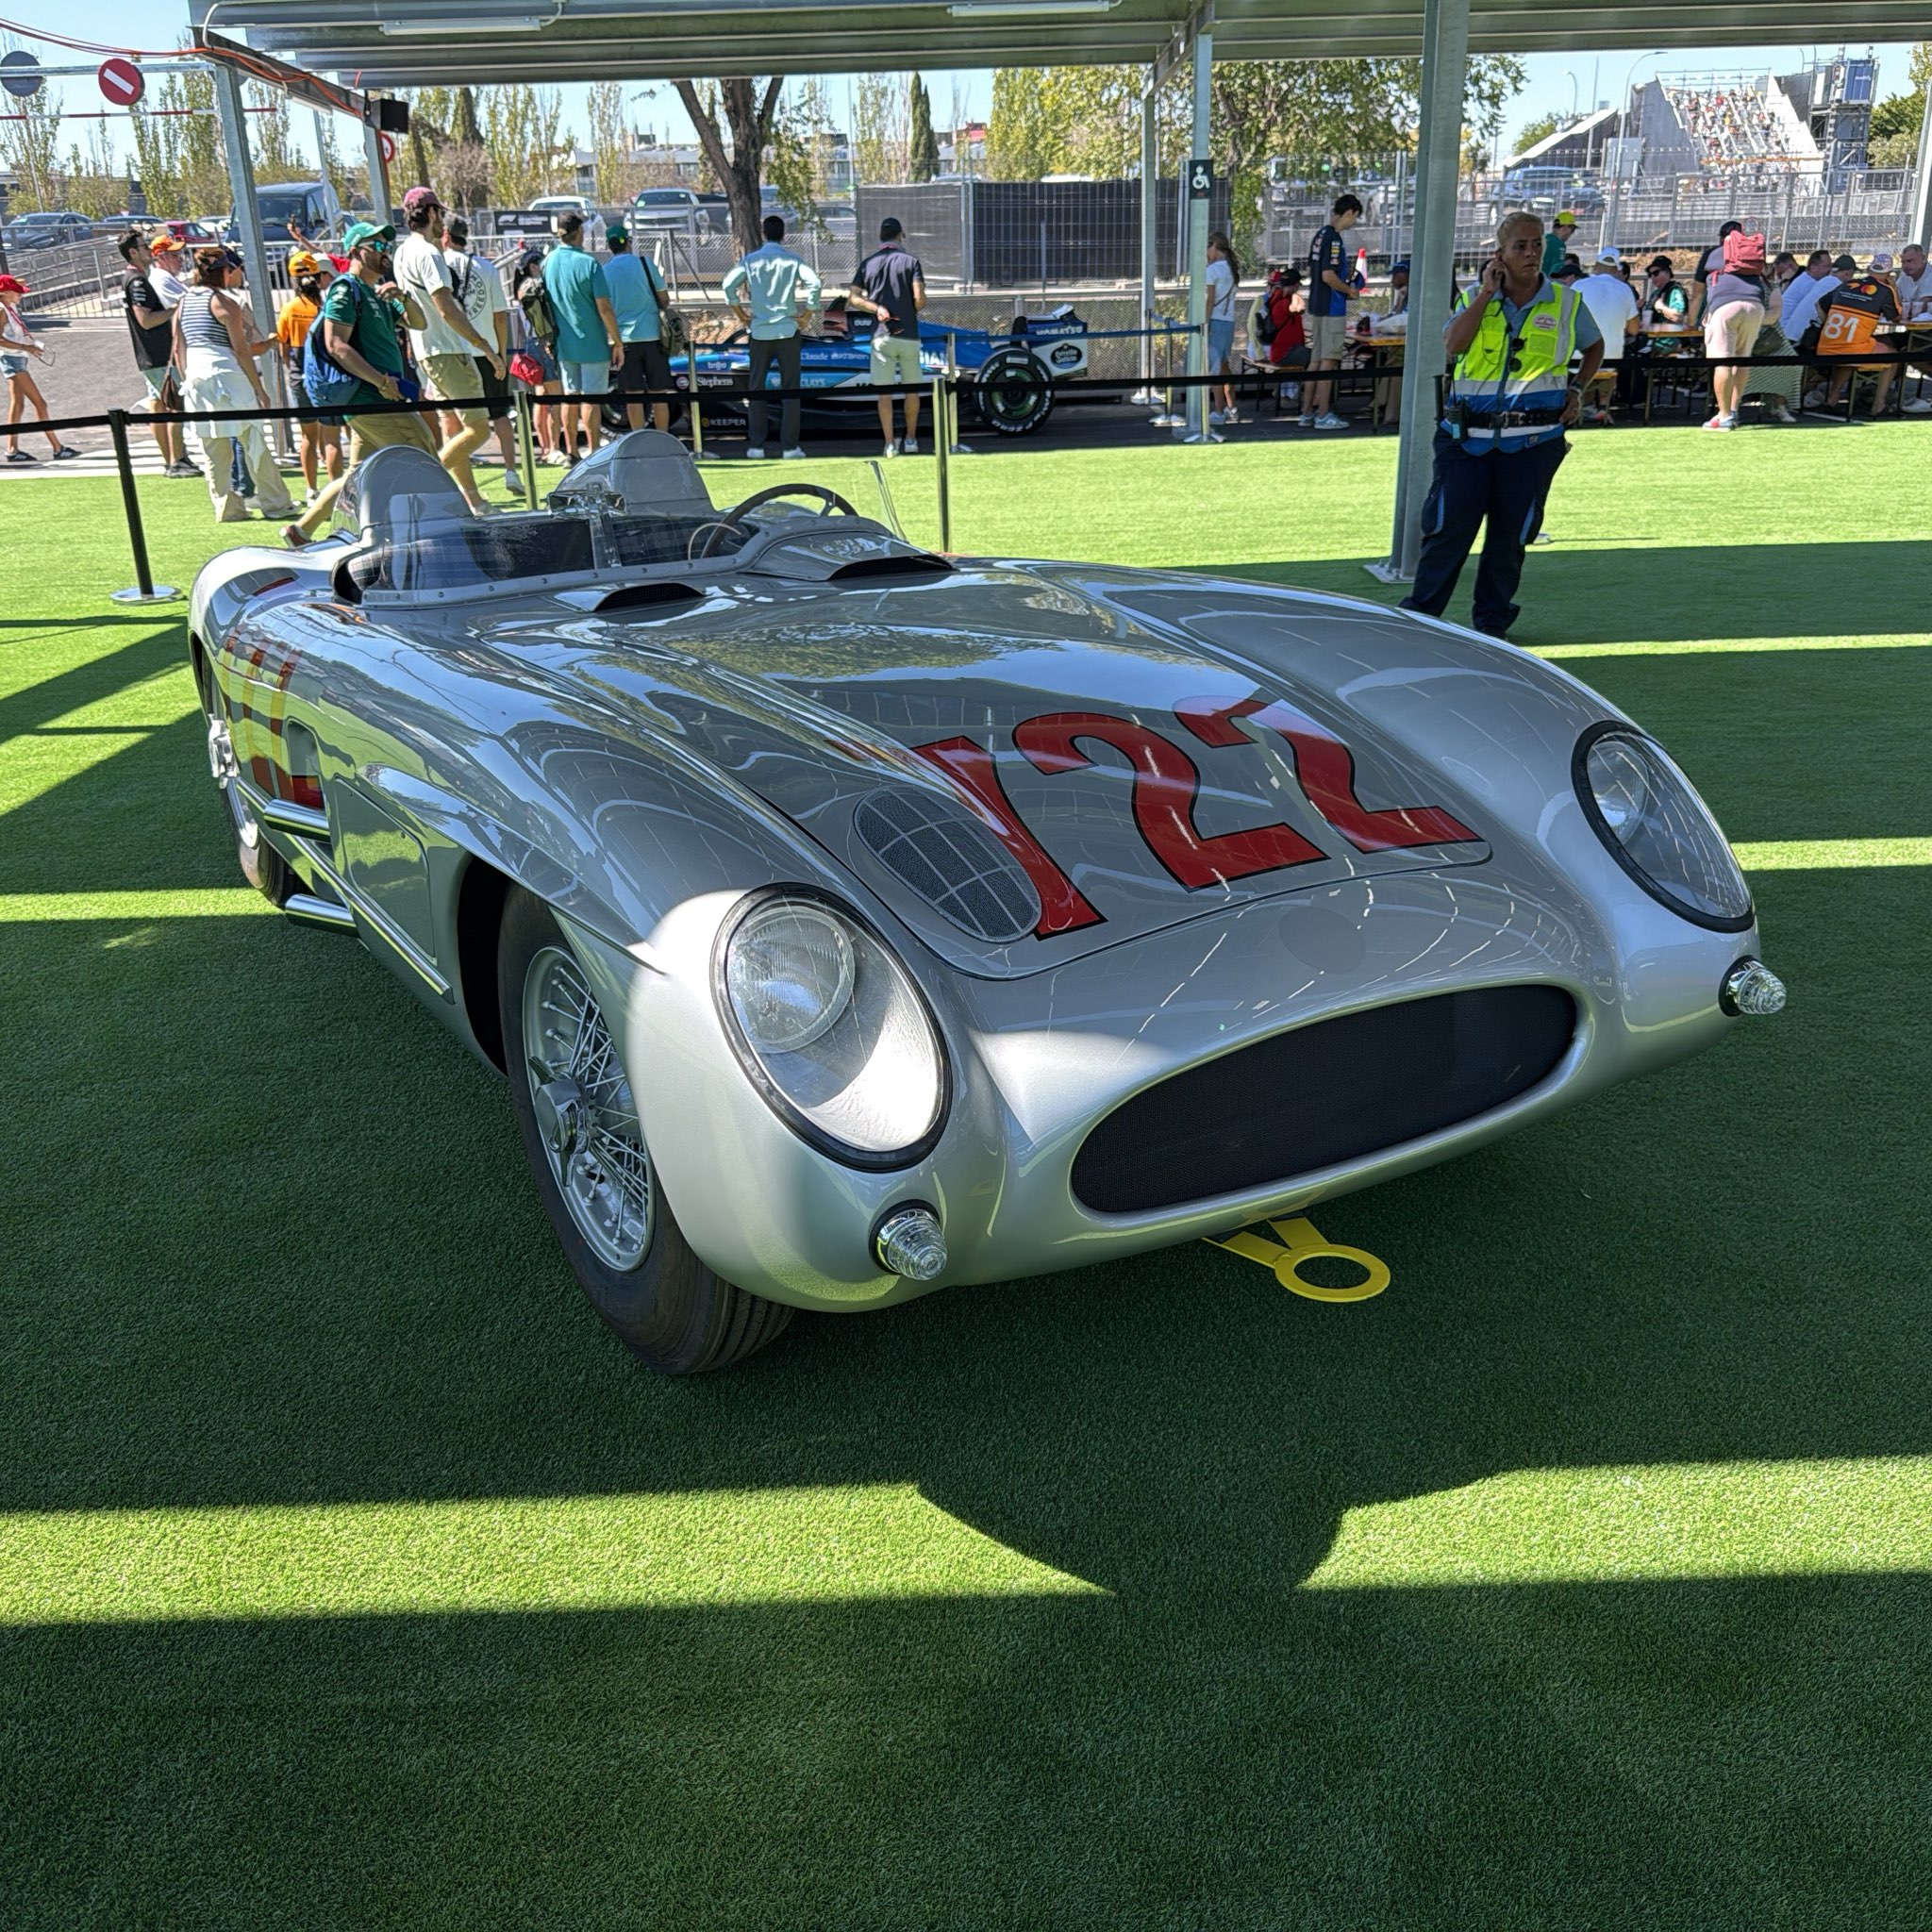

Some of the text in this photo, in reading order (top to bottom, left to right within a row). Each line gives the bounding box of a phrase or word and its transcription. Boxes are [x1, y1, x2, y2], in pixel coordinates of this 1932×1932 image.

[1824, 313, 1859, 343] 81
[697, 375, 734, 388] Stephens
[710, 418, 746, 426] KEEPER
